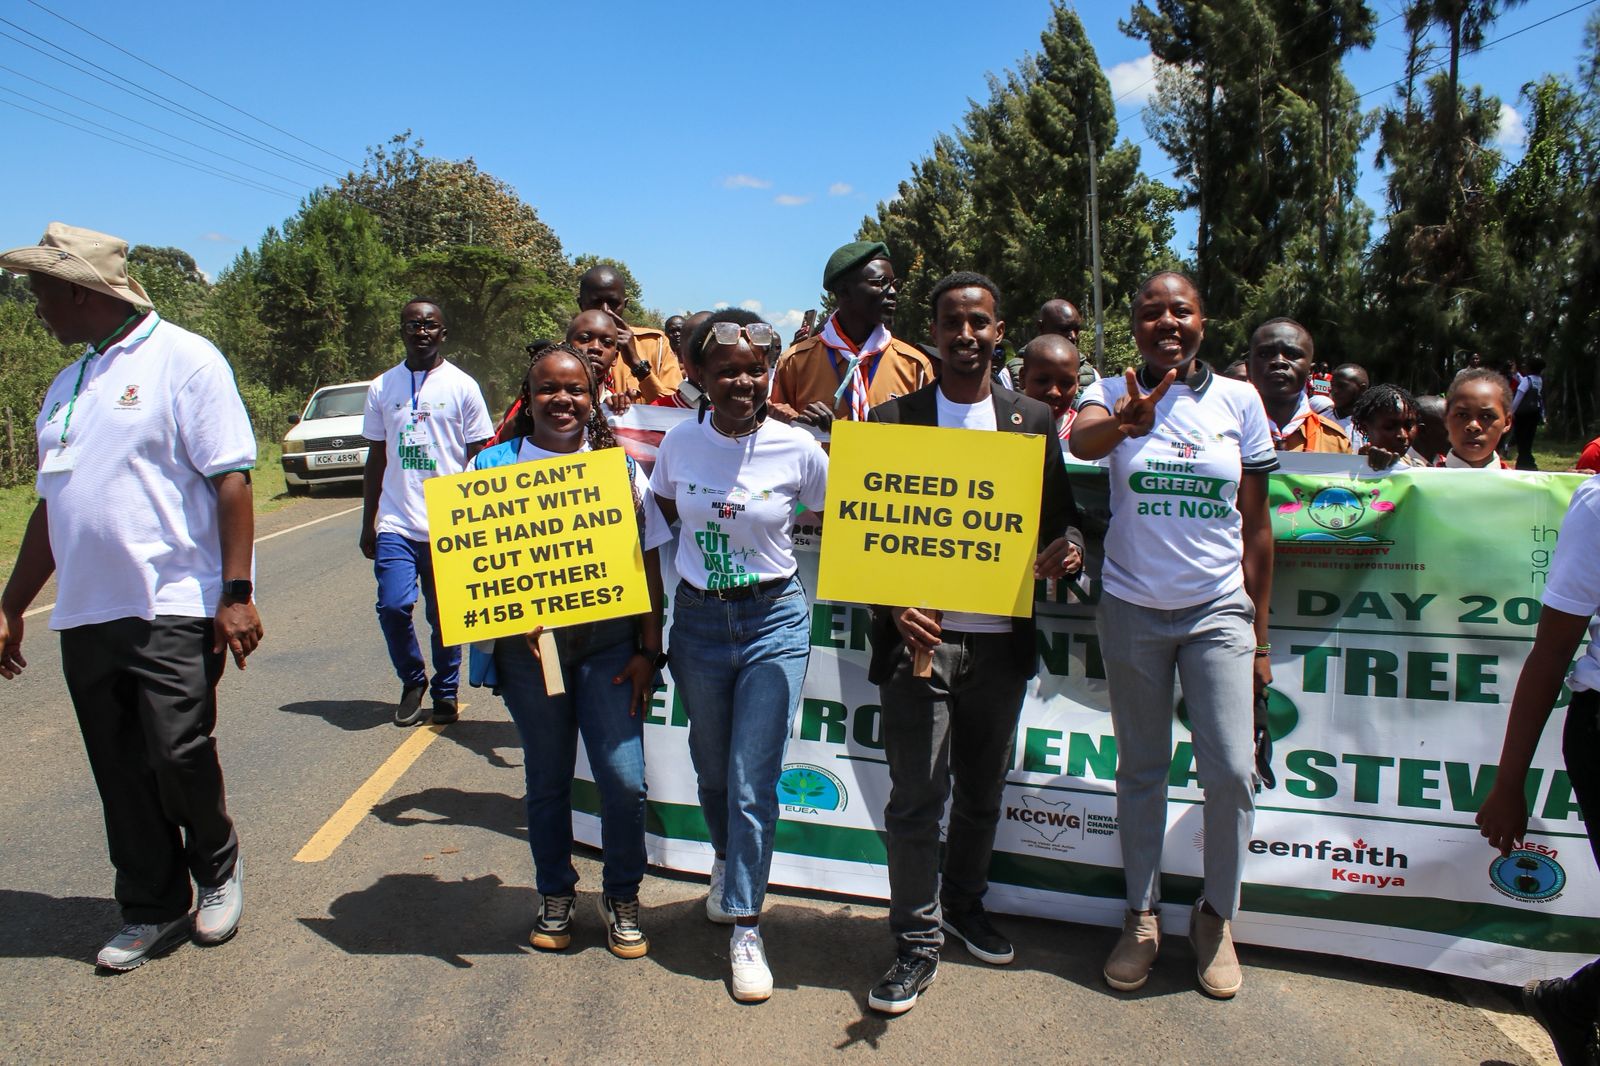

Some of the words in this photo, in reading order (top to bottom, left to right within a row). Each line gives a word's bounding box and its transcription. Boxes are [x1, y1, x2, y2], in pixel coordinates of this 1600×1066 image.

[337, 453, 358, 462] 489K
[398, 445, 421, 458] URE
[402, 458, 437, 470] GREEN
[1144, 459, 1195, 473] Think
[457, 476, 507, 498] YOU
[516, 463, 586, 488] CAN'T
[863, 472, 958, 497] GREED
[967, 479, 995, 500] IS
[1140, 476, 1213, 494] GREEN
[451, 497, 529, 525] PLANT
[537, 486, 601, 510] WITH
[1137, 500, 1172, 516] act
[839, 500, 953, 527] KILLING
[962, 510, 1023, 533] OUR
[437, 530, 493, 553] ONE
[495, 518, 564, 543] HAND
[572, 508, 622, 531] AND
[1531, 525, 1559, 542] th
[695, 531, 729, 553] FUT
[794, 538, 810, 546] 254
[863, 532, 1001, 562] FORESTS!
[1335, 547, 1390, 556] COUNTY
[473, 550, 522, 573] CUT
[530, 538, 594, 563] WITH
[704, 553, 734, 574] URE
[1353, 562, 1425, 571] OPPORTUNITIES
[466, 562, 607, 601] THEOTHER!
[707, 573, 760, 590] GREEN
[463, 602, 524, 628] #15B
[531, 586, 624, 616] TREES?
[1297, 589, 1438, 621] DAY
[1458, 595, 1543, 626] 20
[1290, 645, 1499, 704] TREE
[1285, 749, 1585, 822] STEWA
[785, 805, 819, 815] EUEA
[1006, 806, 1081, 829] KCCWG
[1087, 813, 1113, 823] KENYA
[1086, 828, 1114, 836] GROUP
[1087, 821, 1120, 830] CHANGE
[1248, 838, 1408, 869] eenfaith
[1511, 842, 1558, 860] UESA
[1331, 867, 1405, 889] Kenya
